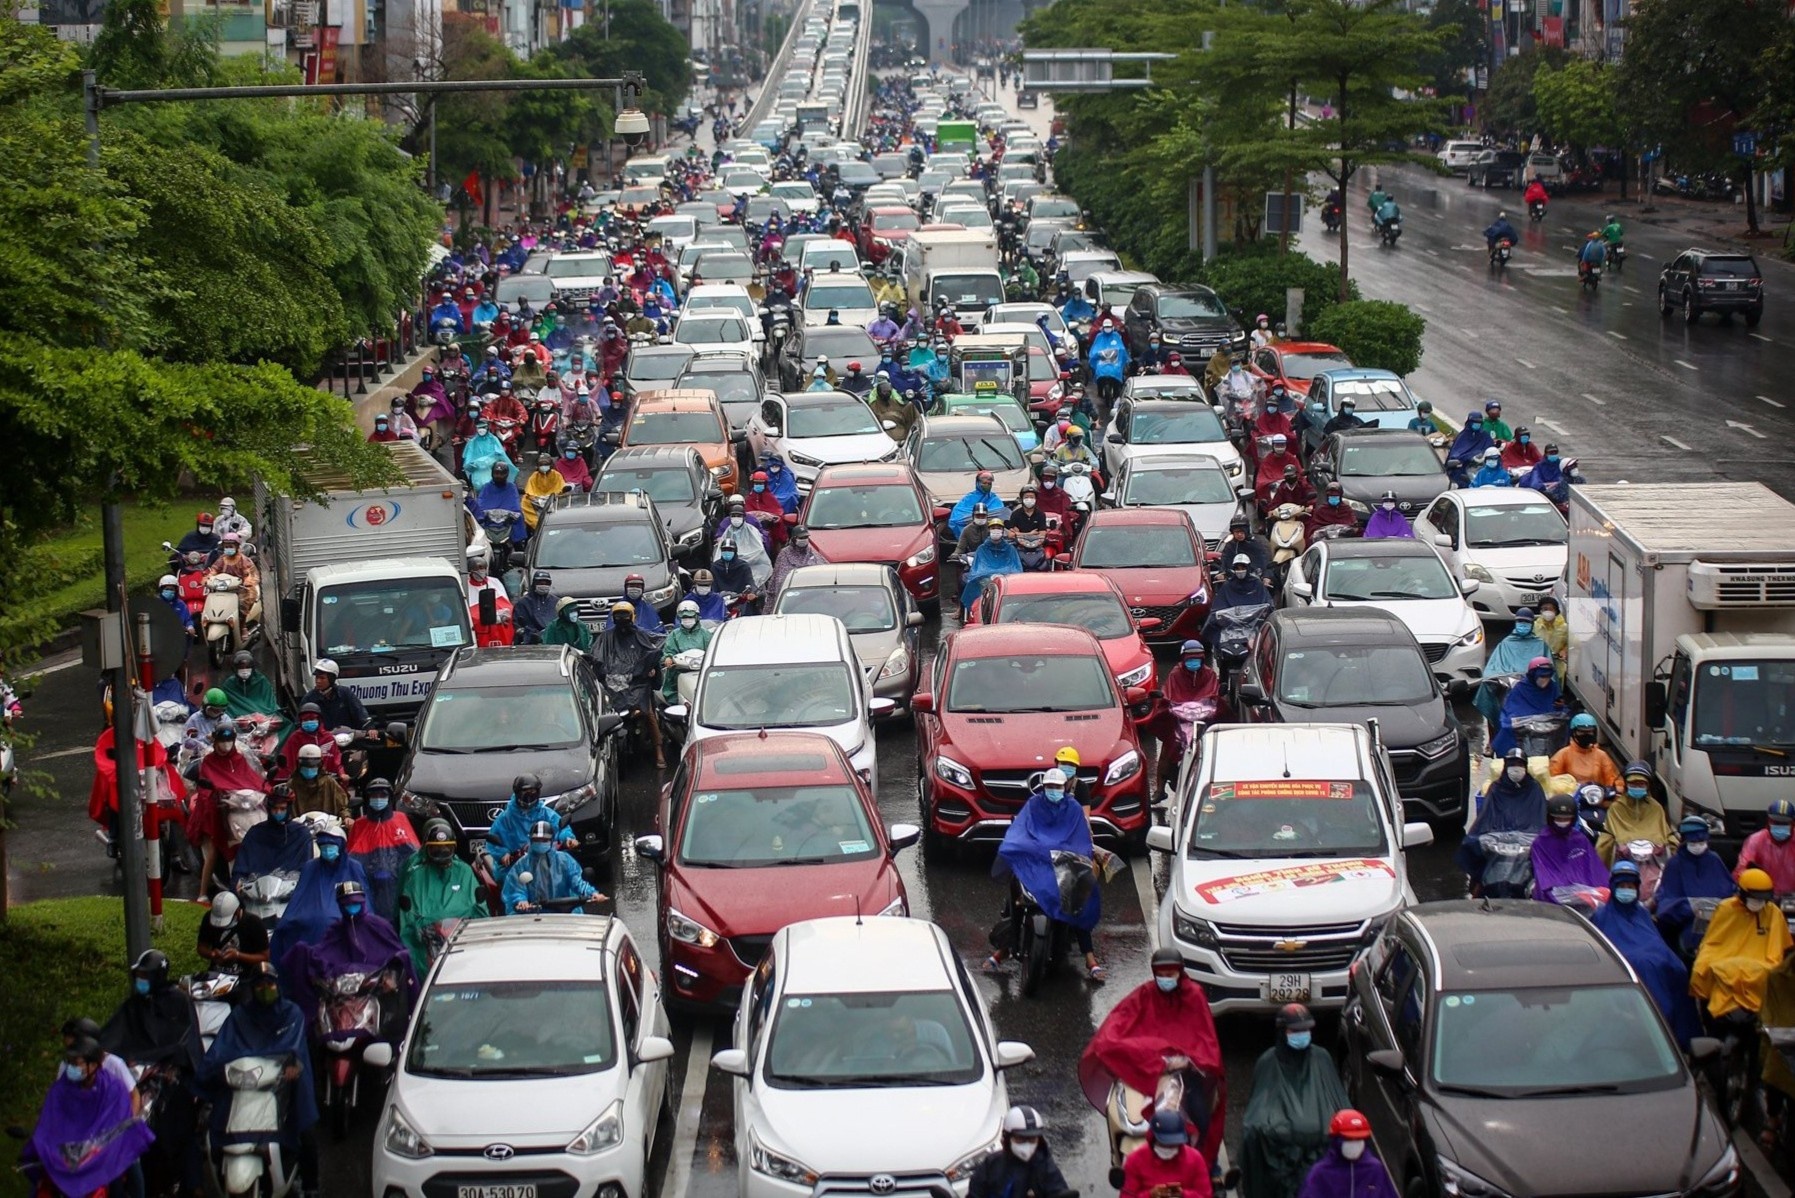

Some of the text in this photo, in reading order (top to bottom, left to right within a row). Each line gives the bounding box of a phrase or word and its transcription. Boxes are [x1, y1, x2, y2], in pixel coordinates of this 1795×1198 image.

[379, 664, 418, 675] ISUZU
[350, 684, 388, 699] Phuong
[391, 681, 409, 697] Thu
[1280, 975, 1301, 987] 29H
